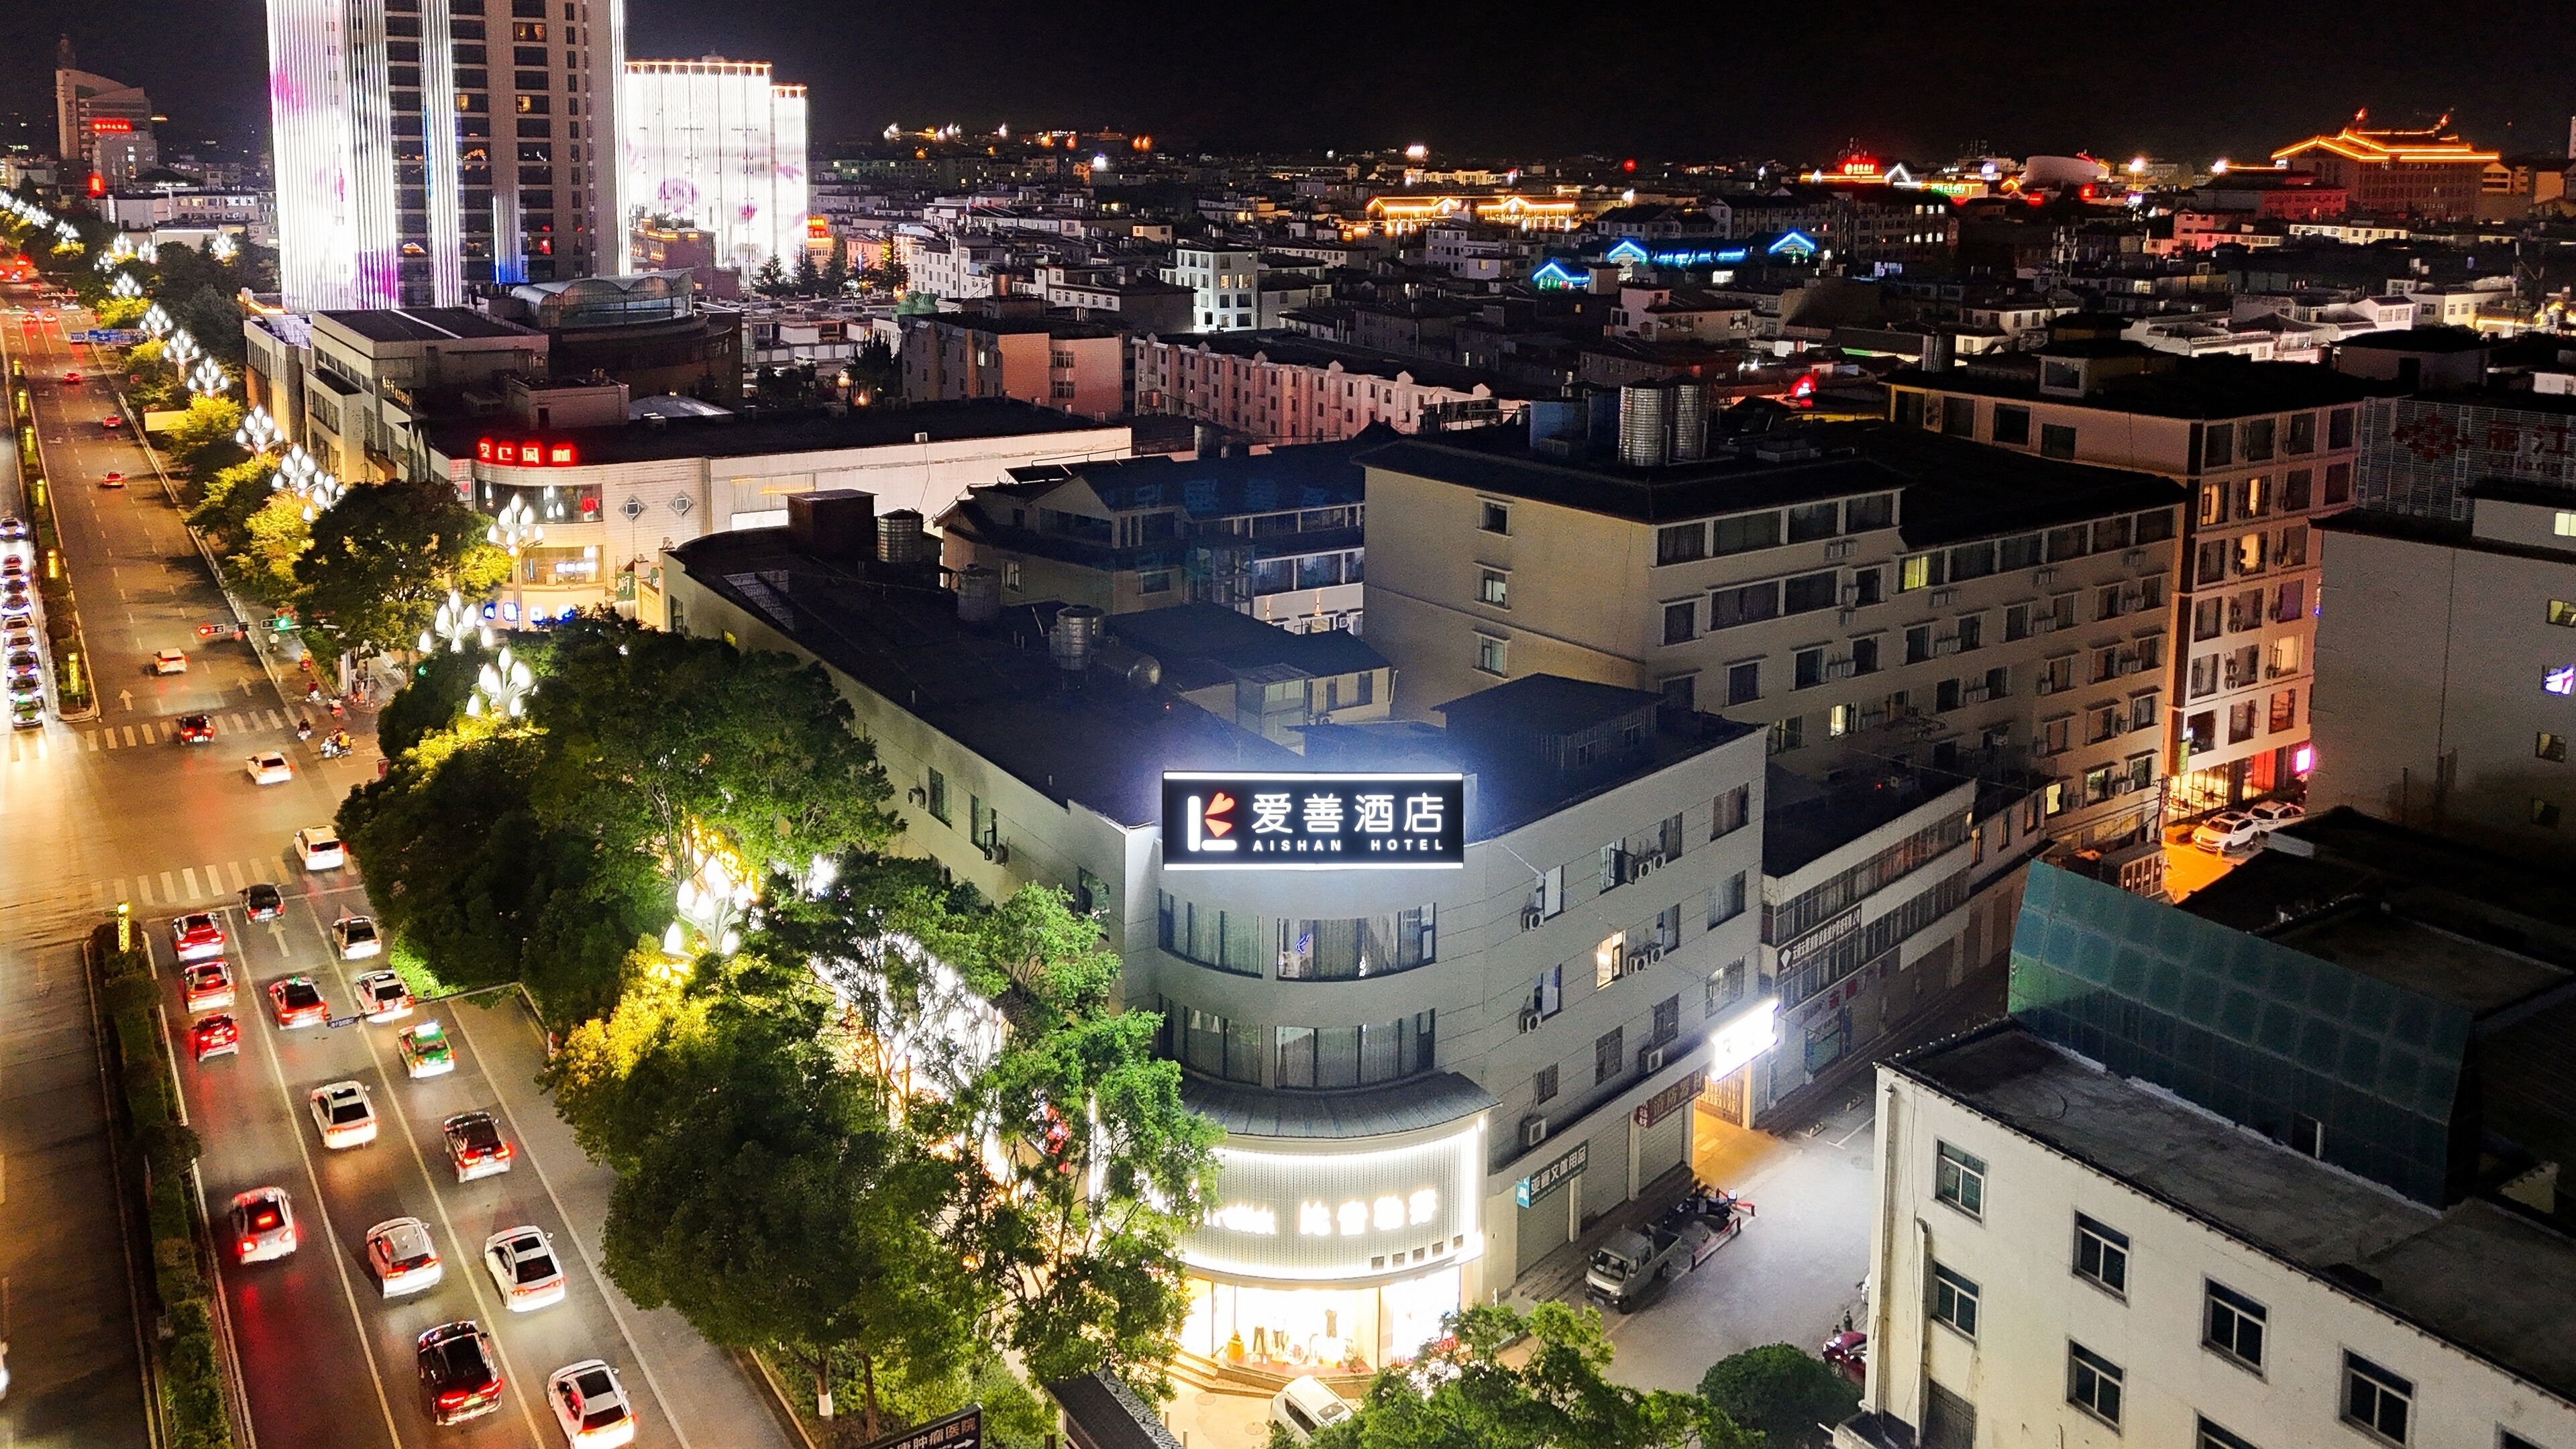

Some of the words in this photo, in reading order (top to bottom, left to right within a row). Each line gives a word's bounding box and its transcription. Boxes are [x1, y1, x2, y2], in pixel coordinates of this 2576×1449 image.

[1252, 792, 1444, 833] 爱善酒店
[1252, 839, 1342, 851] AISHAN
[1371, 839, 1443, 851] HOTEL
